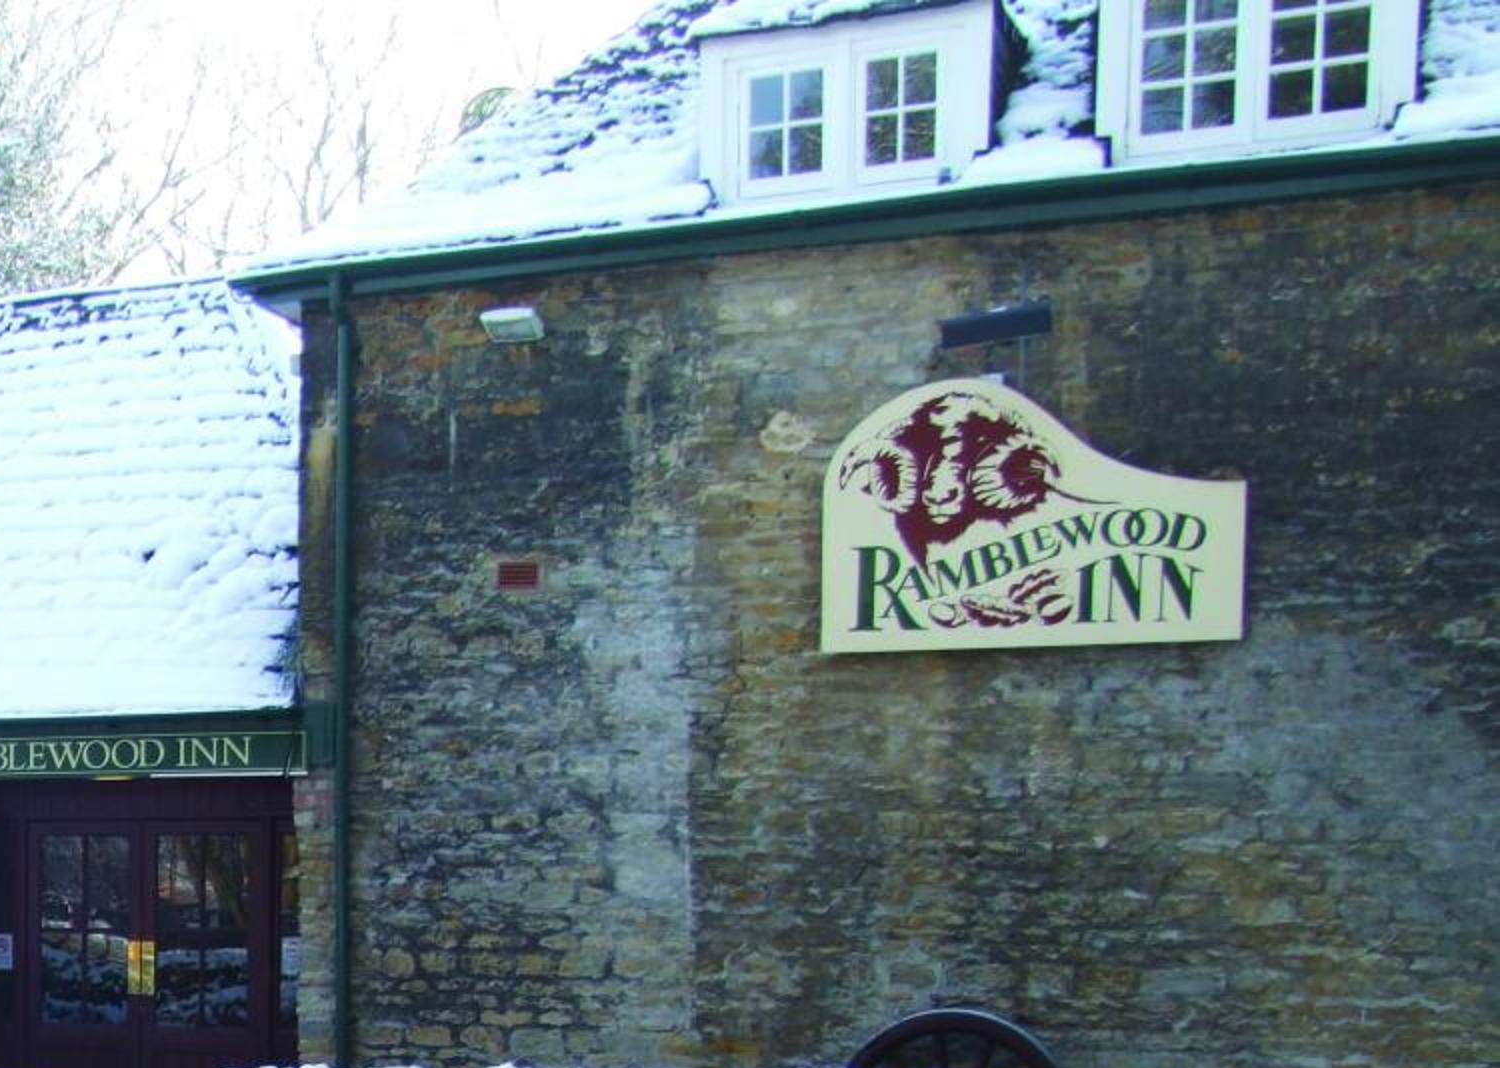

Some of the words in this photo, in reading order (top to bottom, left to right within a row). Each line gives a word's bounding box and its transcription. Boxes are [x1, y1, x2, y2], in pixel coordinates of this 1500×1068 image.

[850, 508, 1207, 632] RAMBLEWOOD
[1074, 553, 1204, 623] INN
[177, 736, 252, 767] INN
